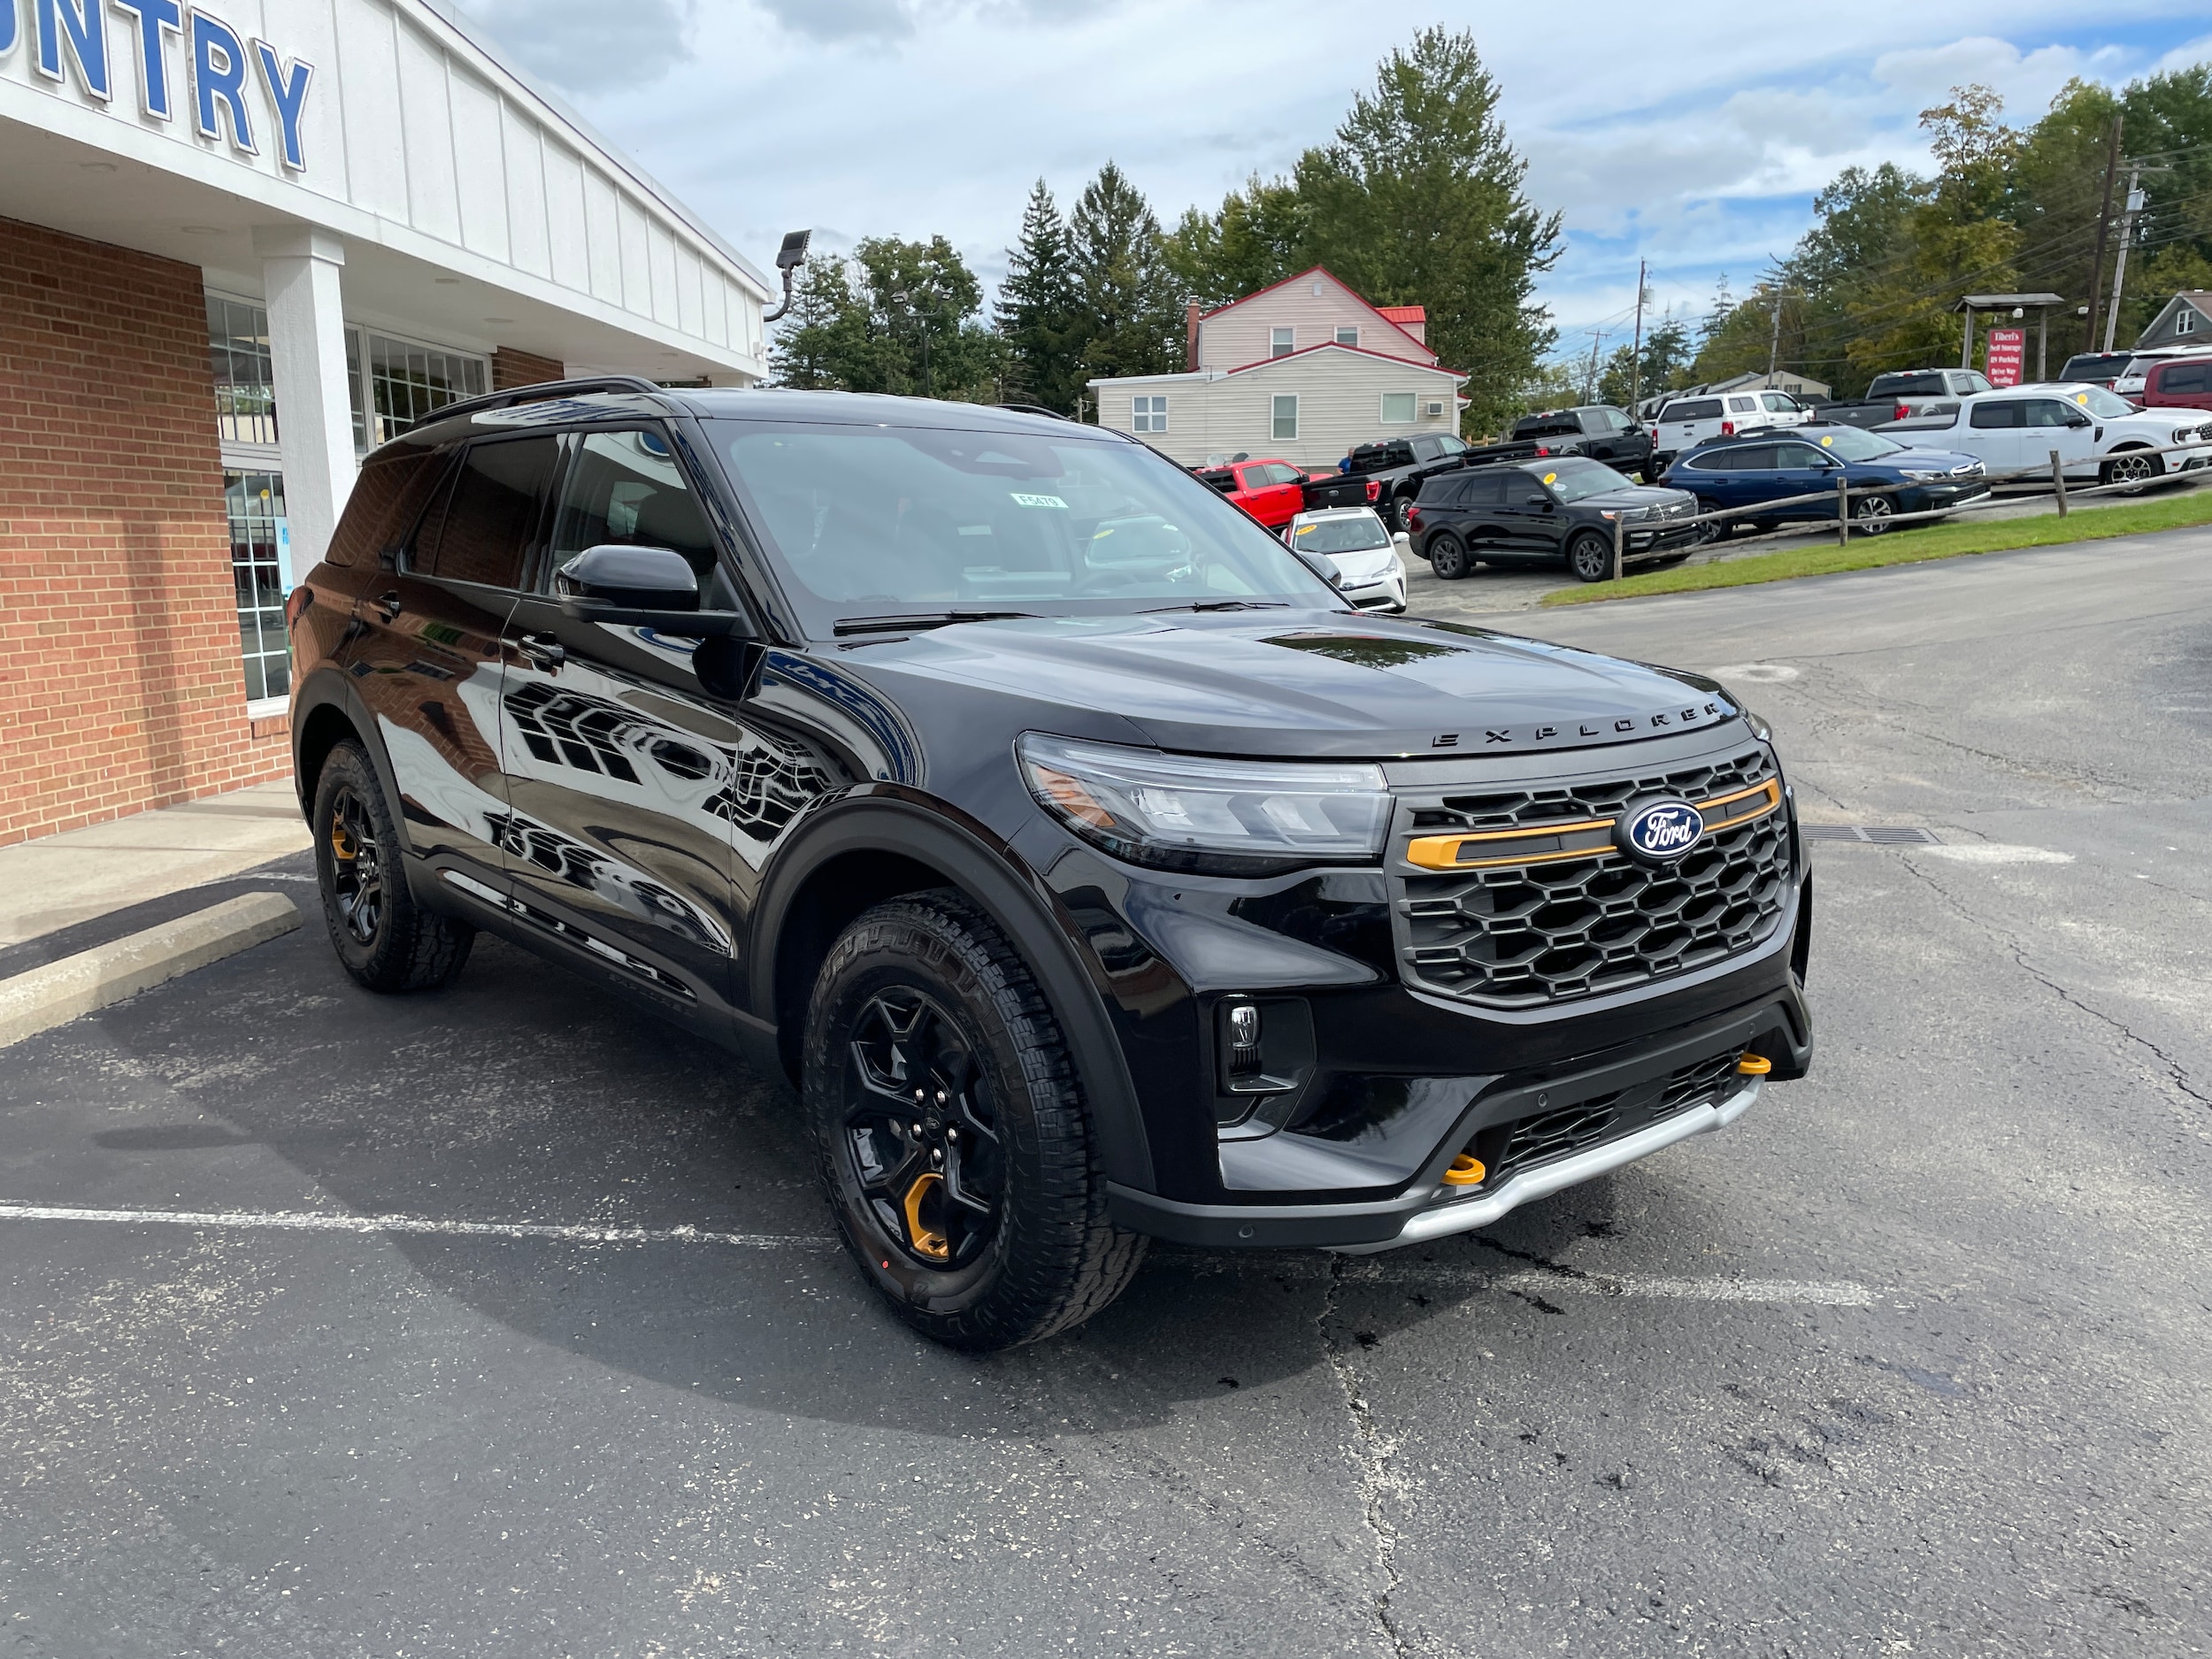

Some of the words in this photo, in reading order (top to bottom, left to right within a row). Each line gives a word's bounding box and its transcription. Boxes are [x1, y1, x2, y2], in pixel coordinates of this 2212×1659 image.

[0, 0, 315, 173] NTRY
[1999, 355, 2019, 364] Parking
[1018, 495, 1058, 505] F5479
[1432, 703, 1721, 749] EXPLORER
[1644, 810, 1693, 849] Ford
